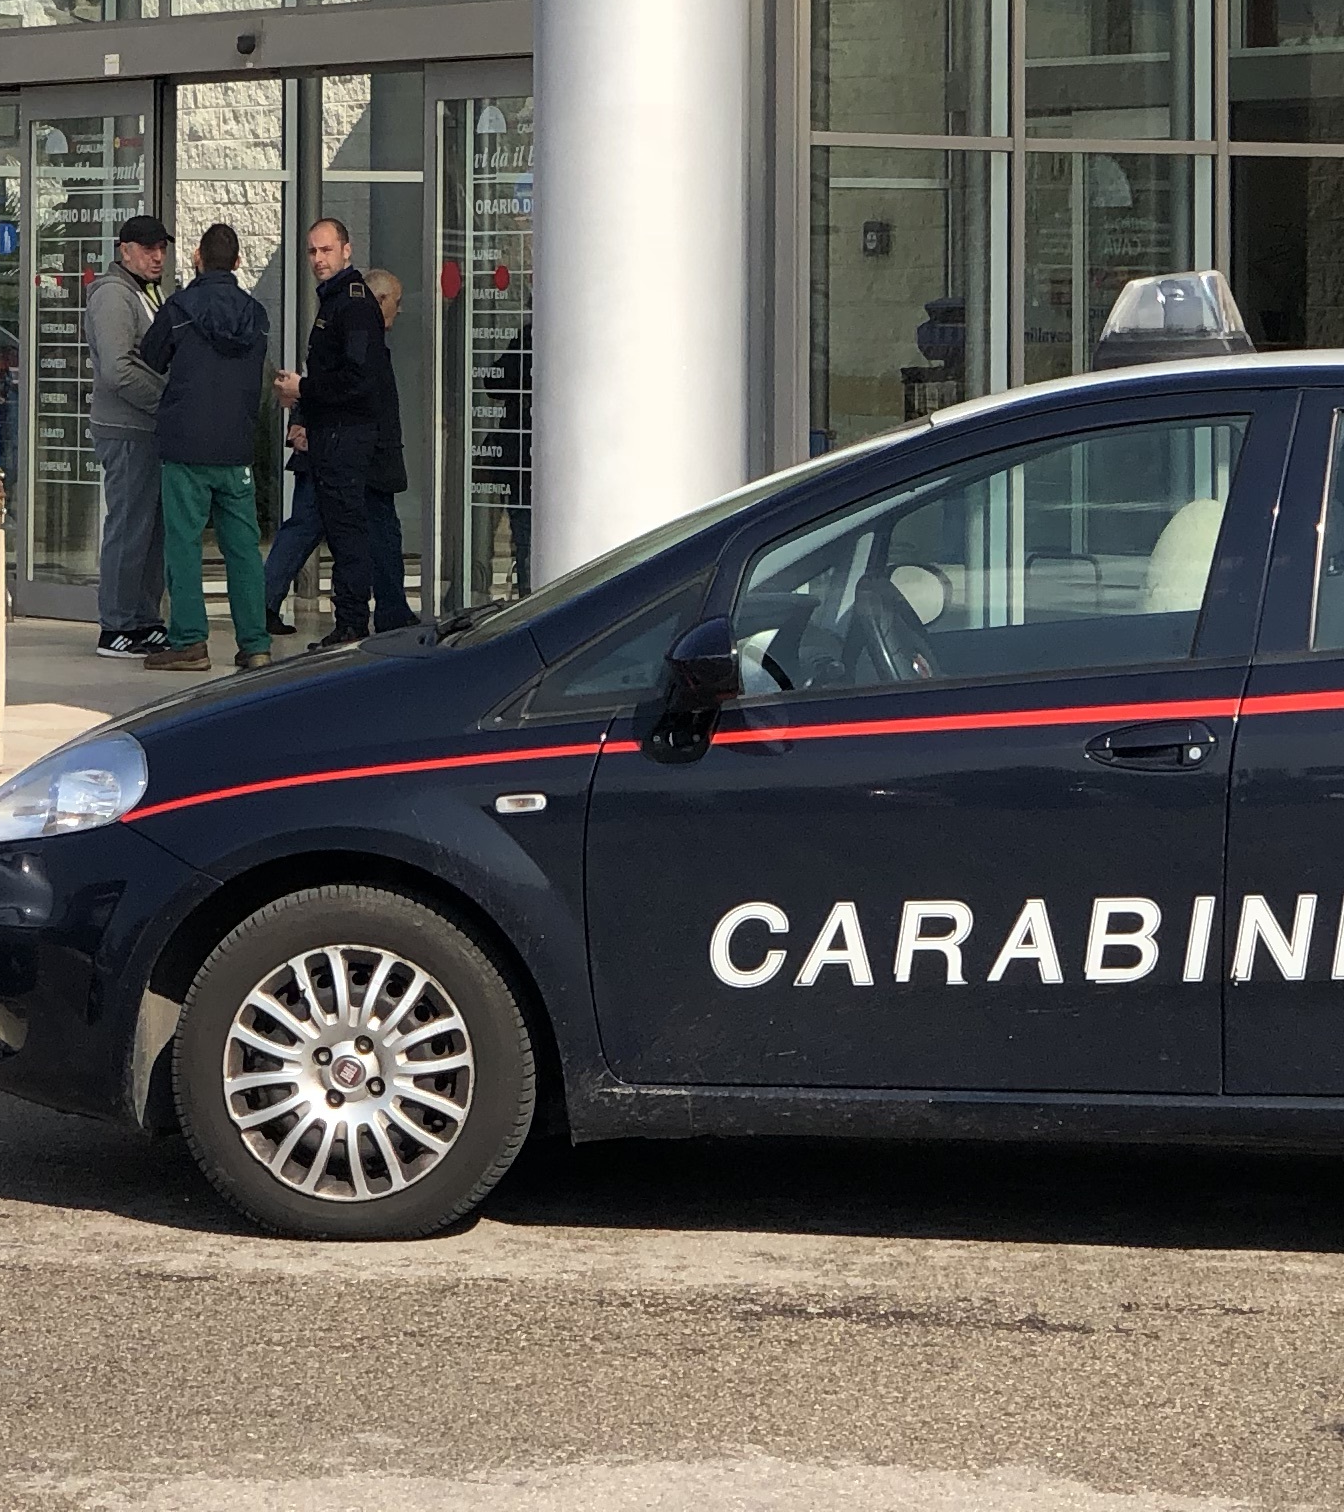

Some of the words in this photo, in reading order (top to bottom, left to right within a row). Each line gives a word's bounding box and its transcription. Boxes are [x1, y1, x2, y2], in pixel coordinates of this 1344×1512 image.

[476, 199, 519, 214] ORARIO
[81, 209, 91, 222] DI
[472, 446, 503, 458] SABATO
